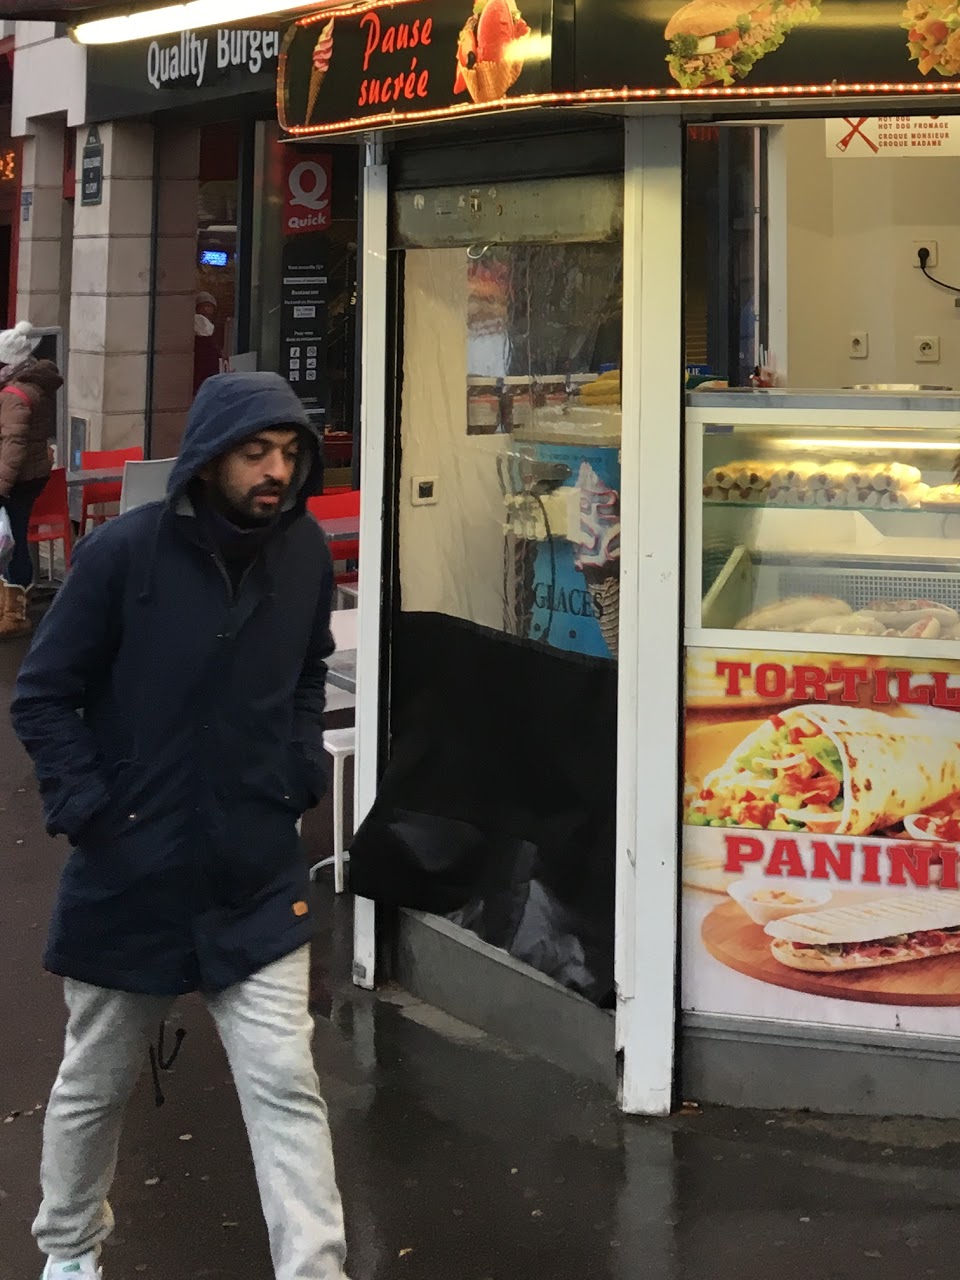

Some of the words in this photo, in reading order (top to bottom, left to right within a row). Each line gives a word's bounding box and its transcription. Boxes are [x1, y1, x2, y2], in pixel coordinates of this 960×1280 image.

[146, 29, 209, 89] Quality
[359, 12, 433, 71] Pause
[358, 57, 429, 107] sucrée
[288, 161, 329, 210] Q
[288, 212, 326, 229] Quick
[534, 582, 604, 620] GLACES
